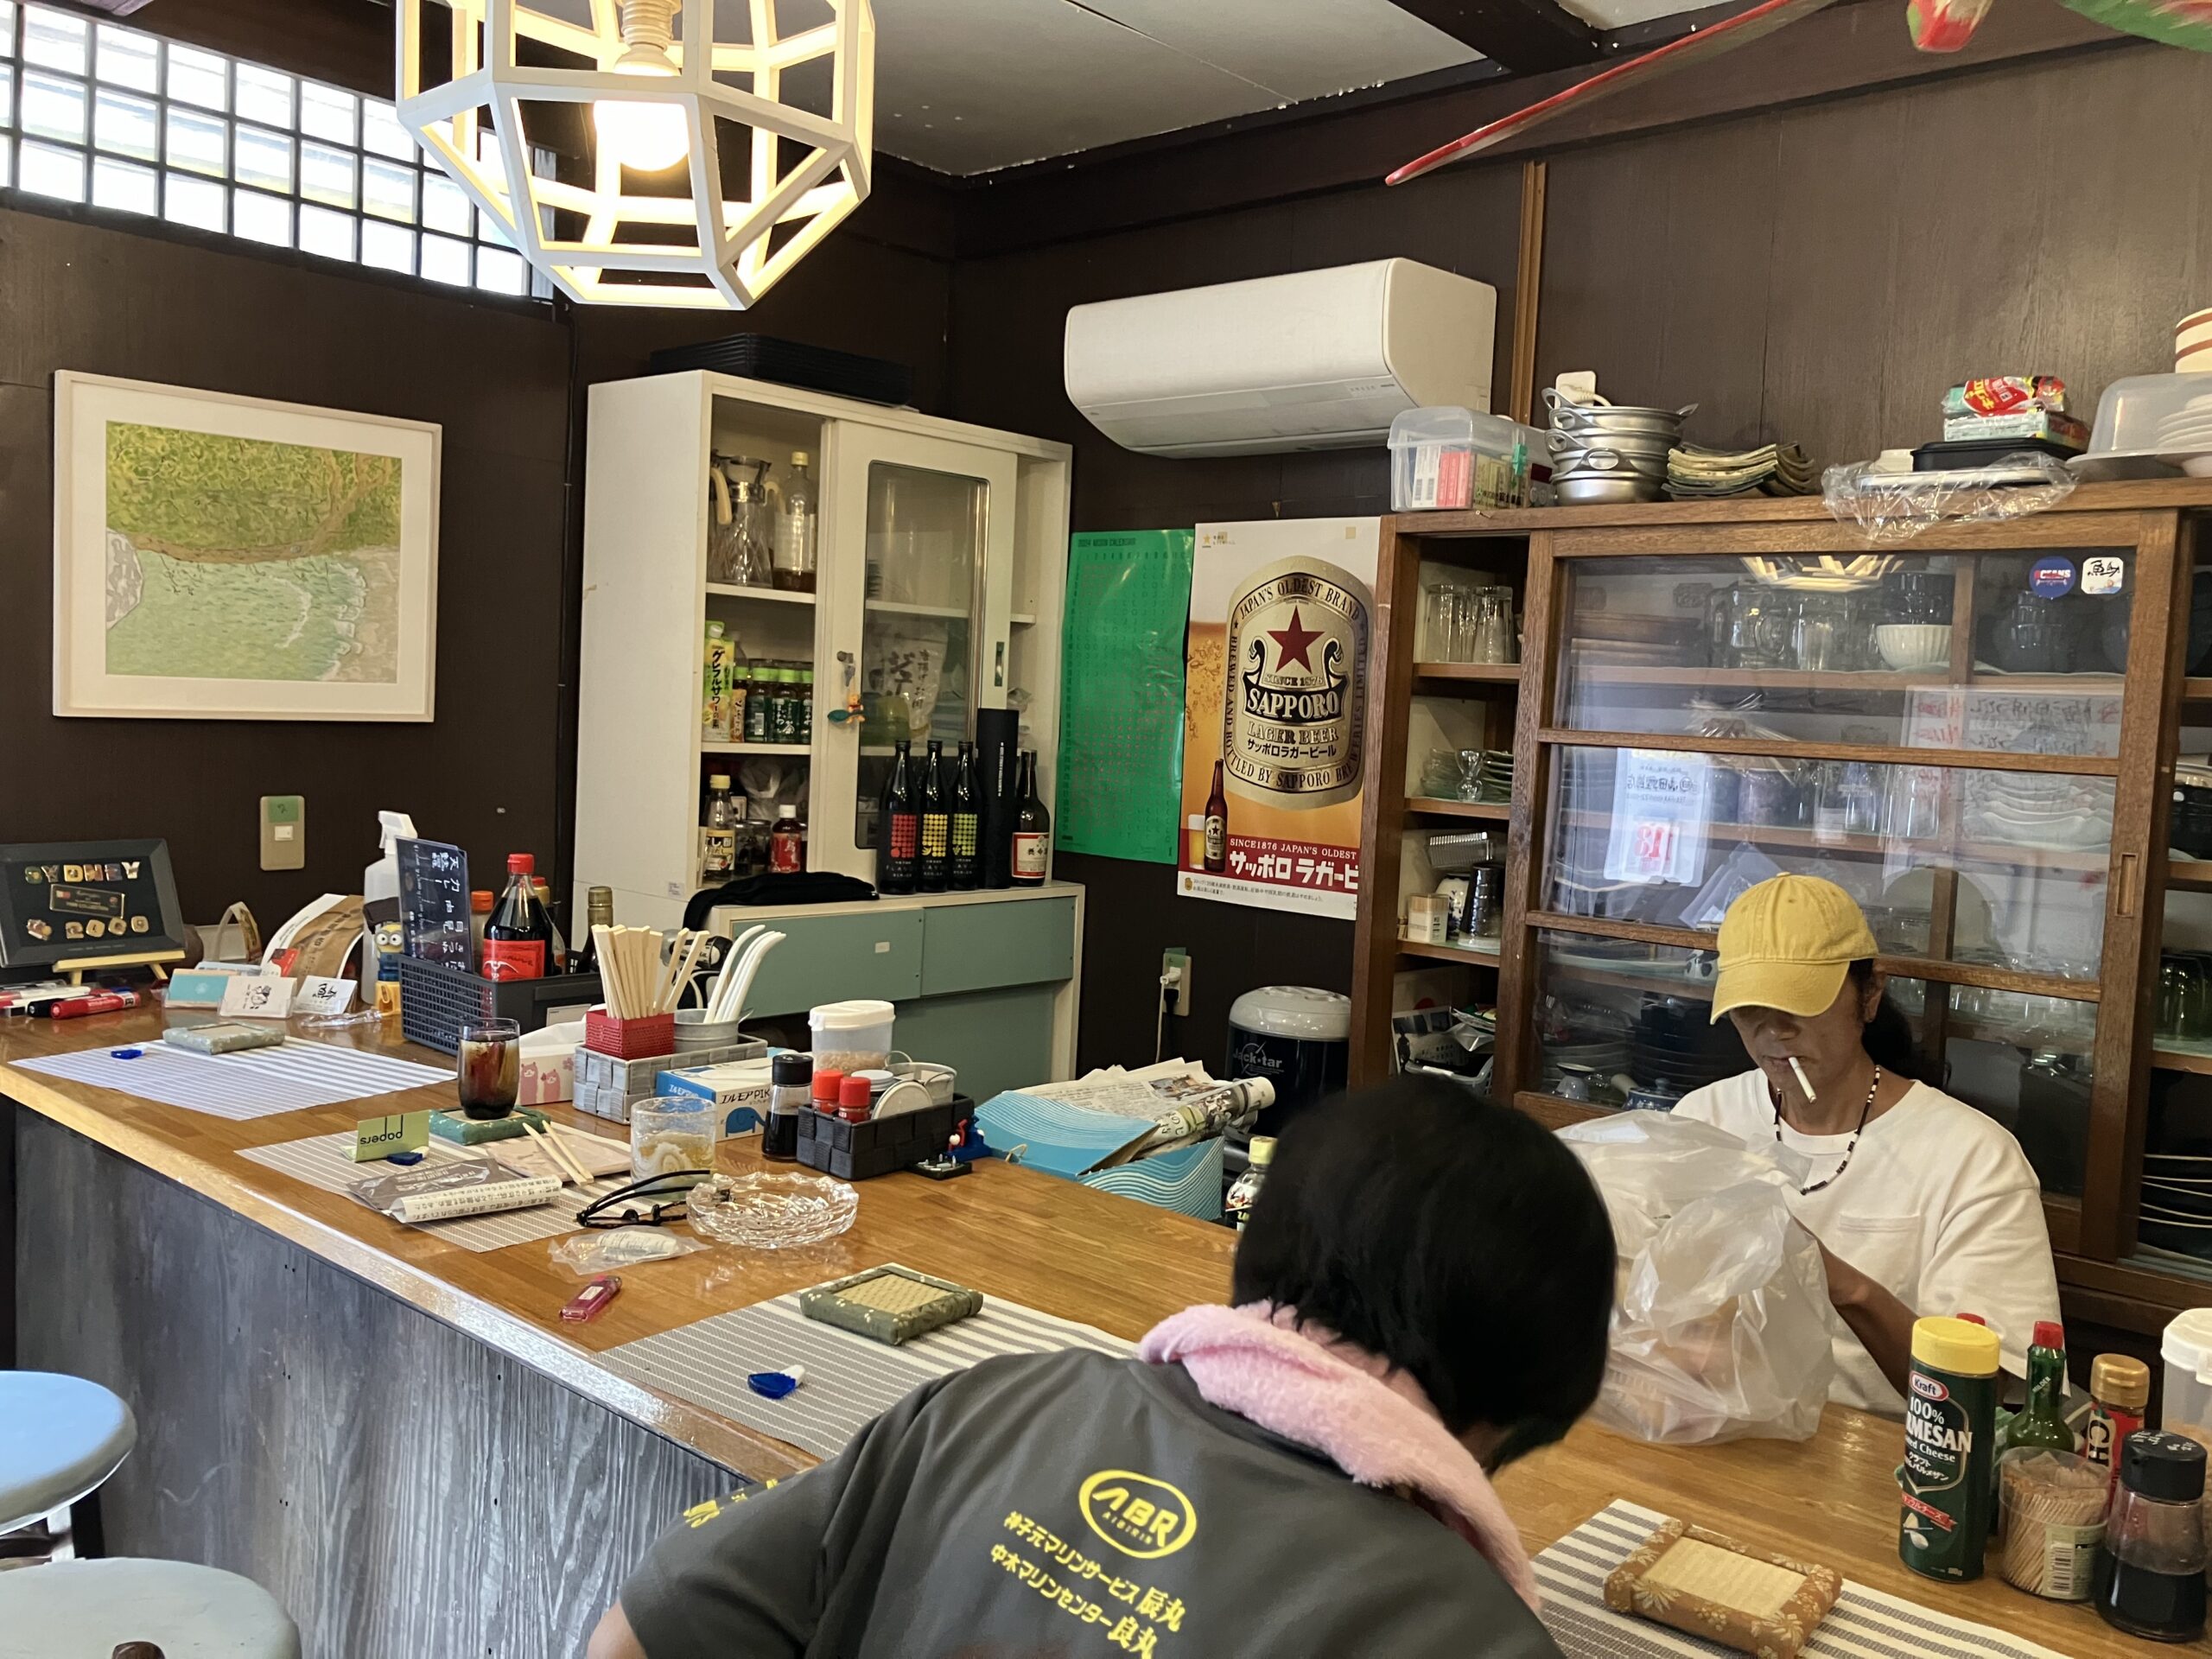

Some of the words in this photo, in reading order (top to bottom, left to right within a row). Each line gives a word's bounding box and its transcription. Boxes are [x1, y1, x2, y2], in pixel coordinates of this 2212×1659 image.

[1240, 588, 1274, 620] JAPAN'S
[1277, 578, 1323, 596] OLDEST
[1325, 588, 1361, 620] BRAND
[1230, 636, 1238, 692] BREWED
[1264, 673, 1298, 686] SINCE
[1226, 696, 1236, 731] AND
[1246, 690, 1340, 720] SAPPORO
[1247, 722, 1297, 744] LAGER
[1299, 727, 1339, 746] BEER
[1226, 733, 1255, 777] BOTTLED
[1247, 739, 1337, 760] サッポロラガービール
[1258, 768, 1273, 785] BY
[1277, 771, 1331, 790] SAPPORO
[1230, 837, 1278, 851] SINCE1876
[1281, 842, 1319, 855] JAPAN'S
[1321, 846, 1357, 861] OLDEST
[359, 1115, 404, 1145] papers
[1914, 1377, 1937, 1396] Kraft
[1910, 1395, 1945, 1426] 100%
[1919, 1443, 1956, 1463] Cheese
[989, 1542, 1113, 1628] 中木マリンセンター
